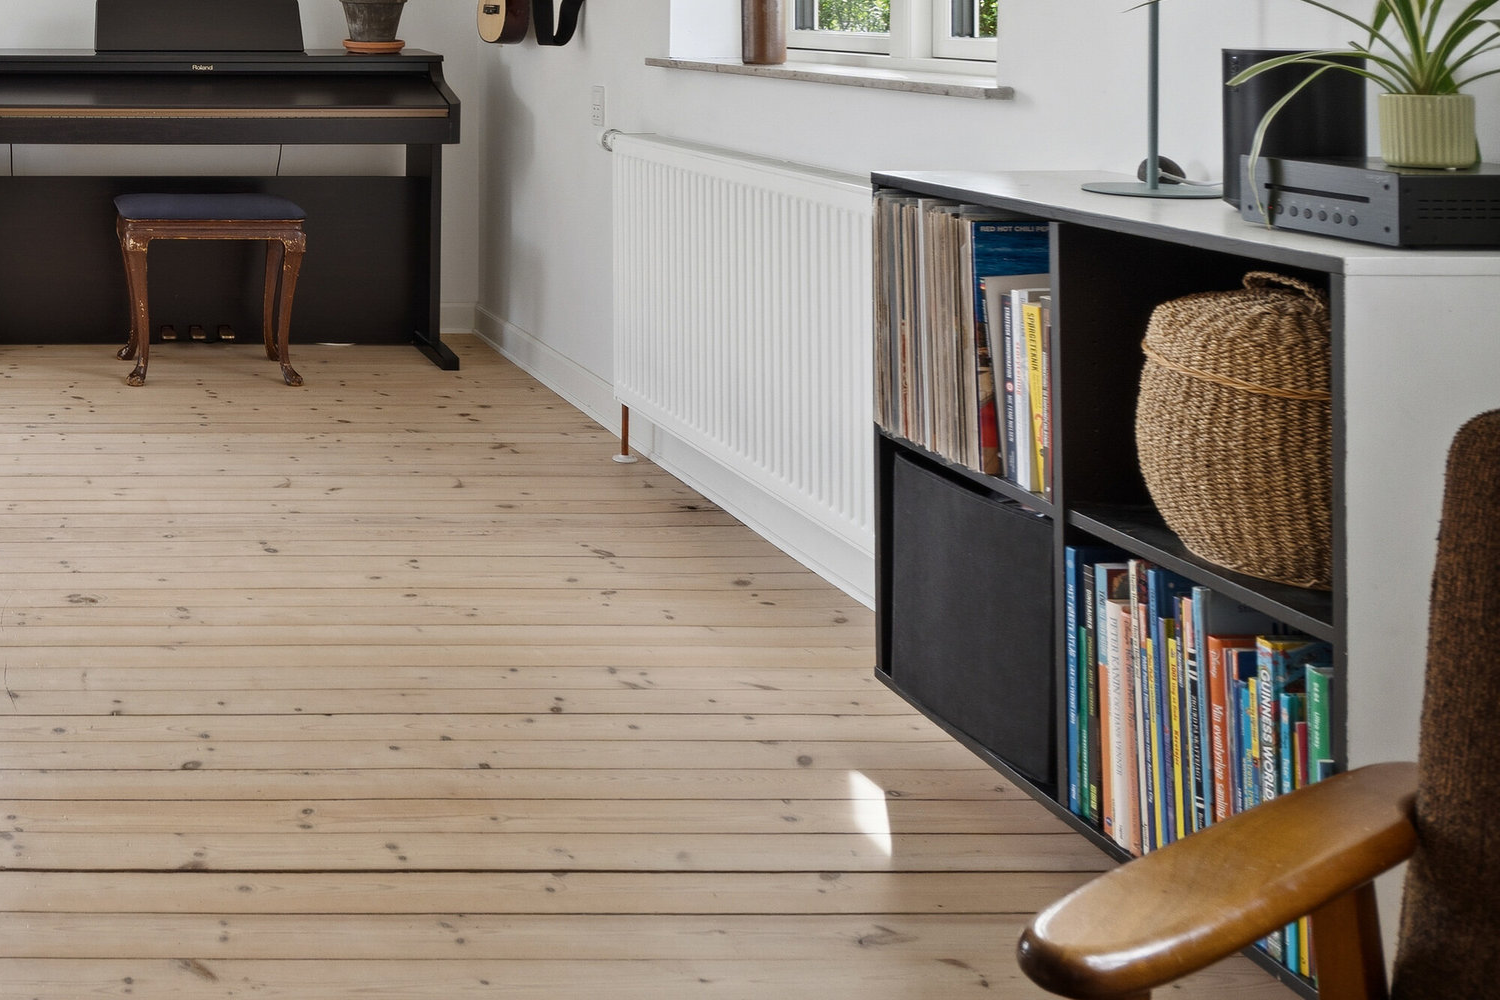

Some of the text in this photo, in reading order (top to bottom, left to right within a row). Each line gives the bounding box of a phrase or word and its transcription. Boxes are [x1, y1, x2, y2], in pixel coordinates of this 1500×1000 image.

[1005, 337, 1013, 378] KOMMUNIKATION
[1027, 312, 1039, 372] SPØRGETEKNIK
[1067, 603, 1075, 632] FØRSTE
[1110, 617, 1119, 652] PETER
[1068, 634, 1076, 657] ATLAS
[1111, 656, 1121, 693] KANIN
[1114, 713, 1122, 738] HANS
[1211, 651, 1228, 819] Disney Min eventyrlige samling
[1260, 670, 1275, 800] GUINNESS WORLD
[1115, 740, 1123, 776] VENNER
[1193, 735, 1201, 782] SKATTEJAGT
